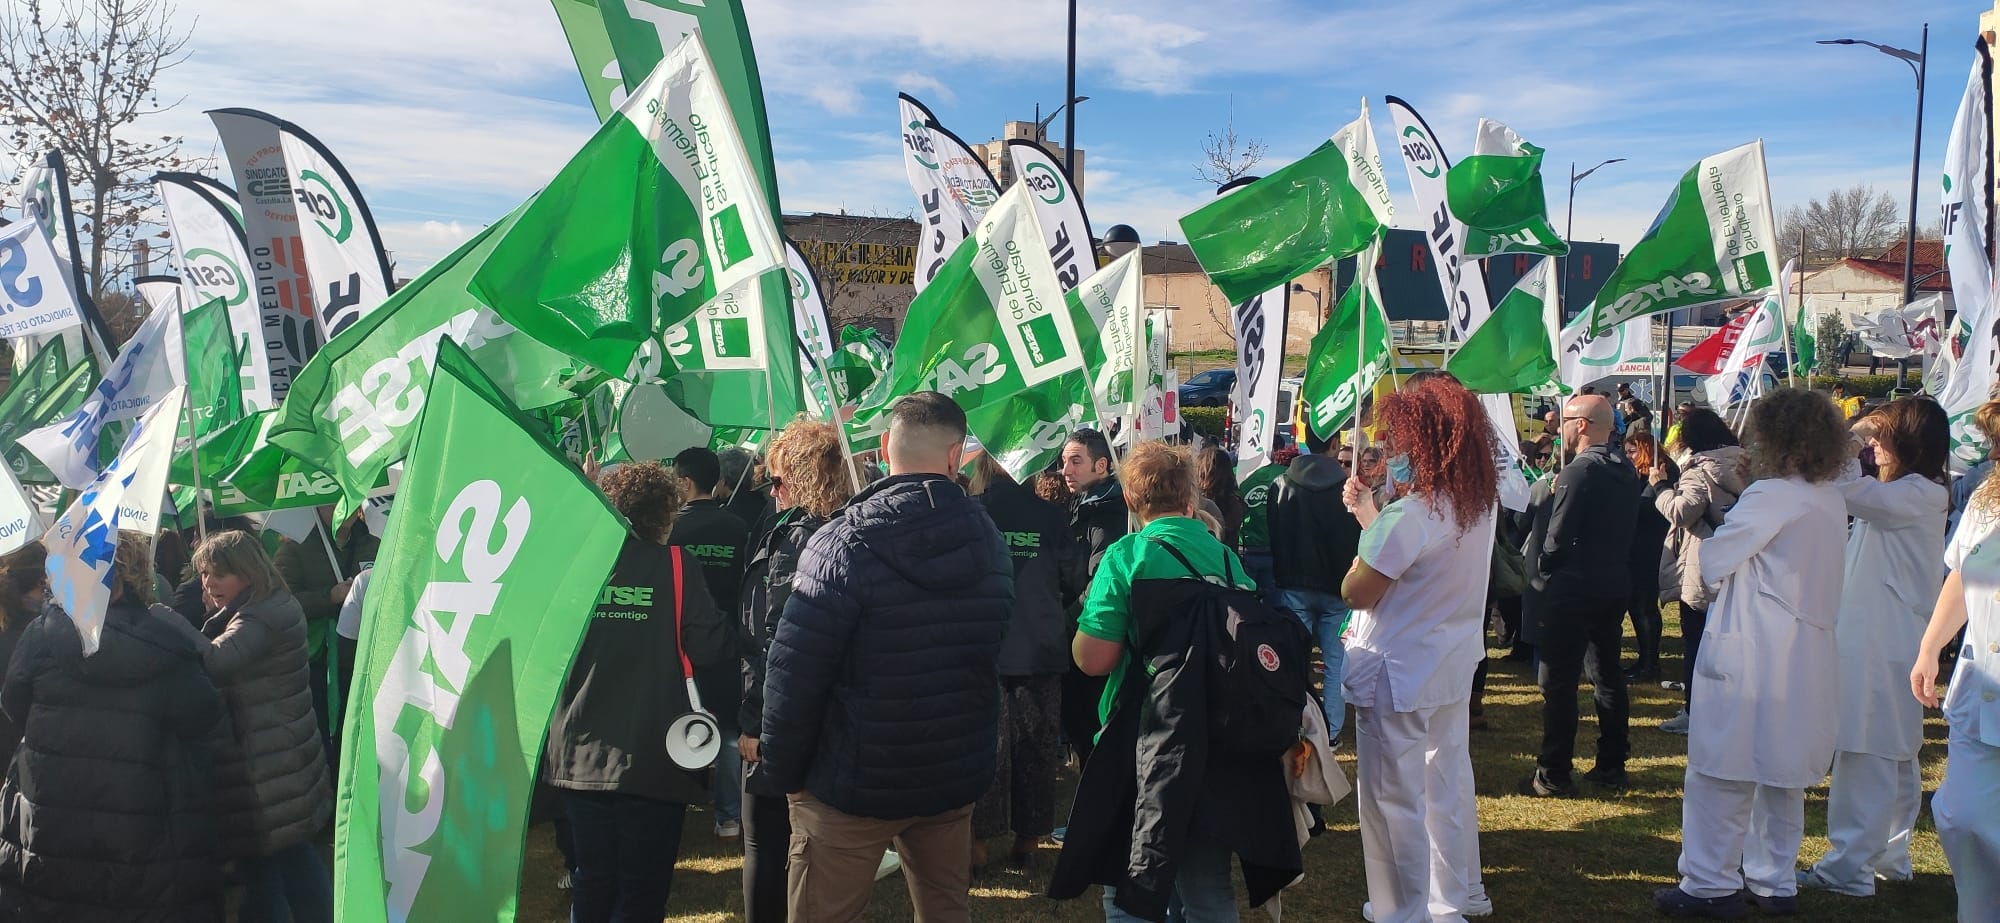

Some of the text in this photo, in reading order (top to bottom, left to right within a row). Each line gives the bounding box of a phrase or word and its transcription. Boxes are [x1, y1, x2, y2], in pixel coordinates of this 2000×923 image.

[245, 167, 287, 180] SINDICATO
[1940, 201, 1964, 236] IF
[847, 270, 886, 285] MAYOR
[888, 271, 898, 285] Y
[899, 271, 915, 285] DE
[254, 246, 282, 328] MÉDICO
[1003, 531, 1041, 547] TSE
[684, 544, 736, 559] SATSE
[608, 611, 649, 621] contigo
